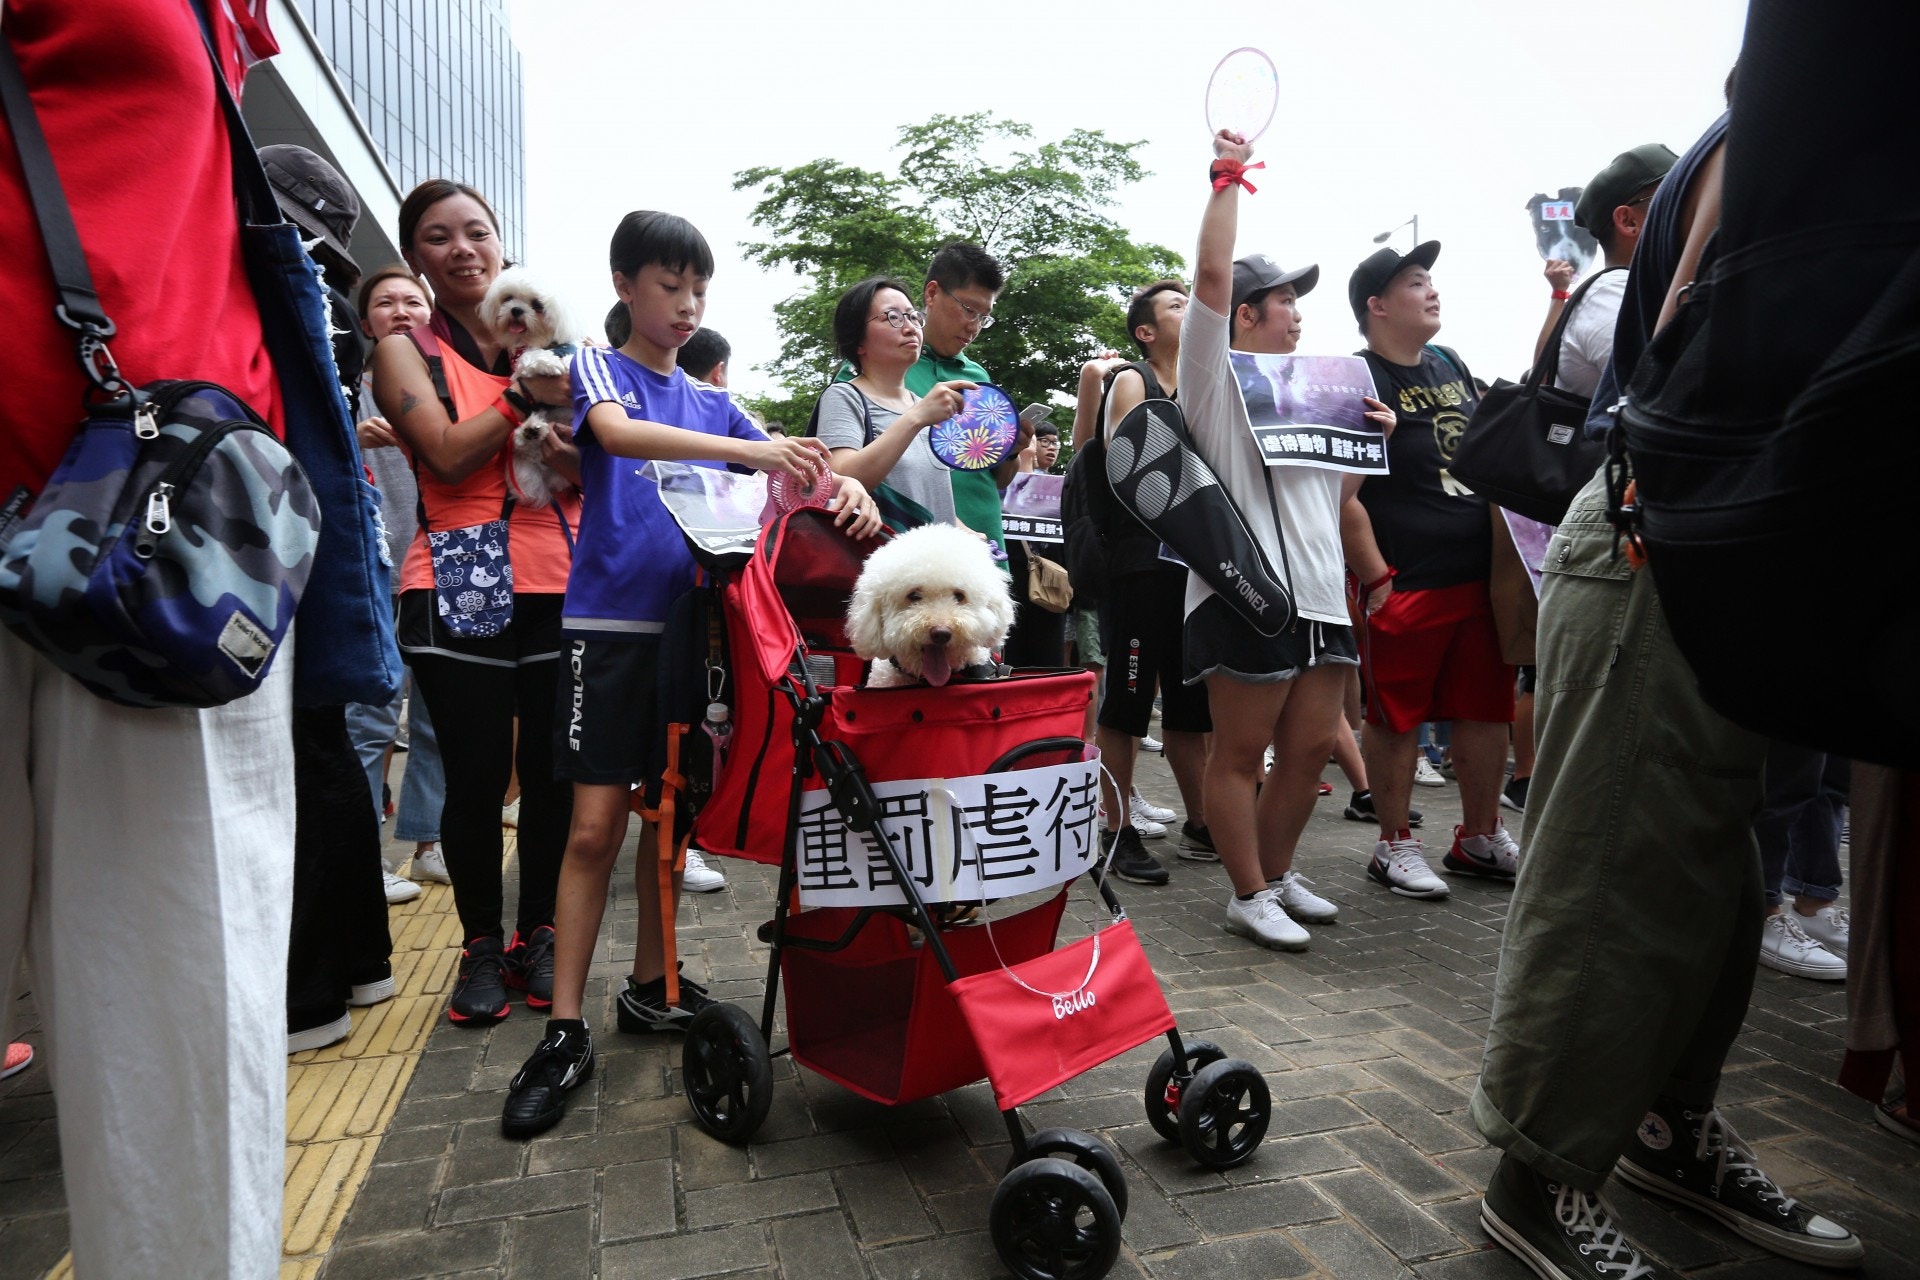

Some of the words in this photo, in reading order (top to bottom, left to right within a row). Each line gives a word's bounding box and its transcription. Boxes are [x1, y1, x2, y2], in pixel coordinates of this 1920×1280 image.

[1262, 433, 1327, 455] 虐待動物
[1331, 437, 1383, 462] 監禁十年
[1235, 575, 1270, 616] YONEX
[1127, 649, 1139, 694] RESTART
[799, 772, 1098, 891] 重罰虐待
[1051, 988, 1096, 1020] Bello
